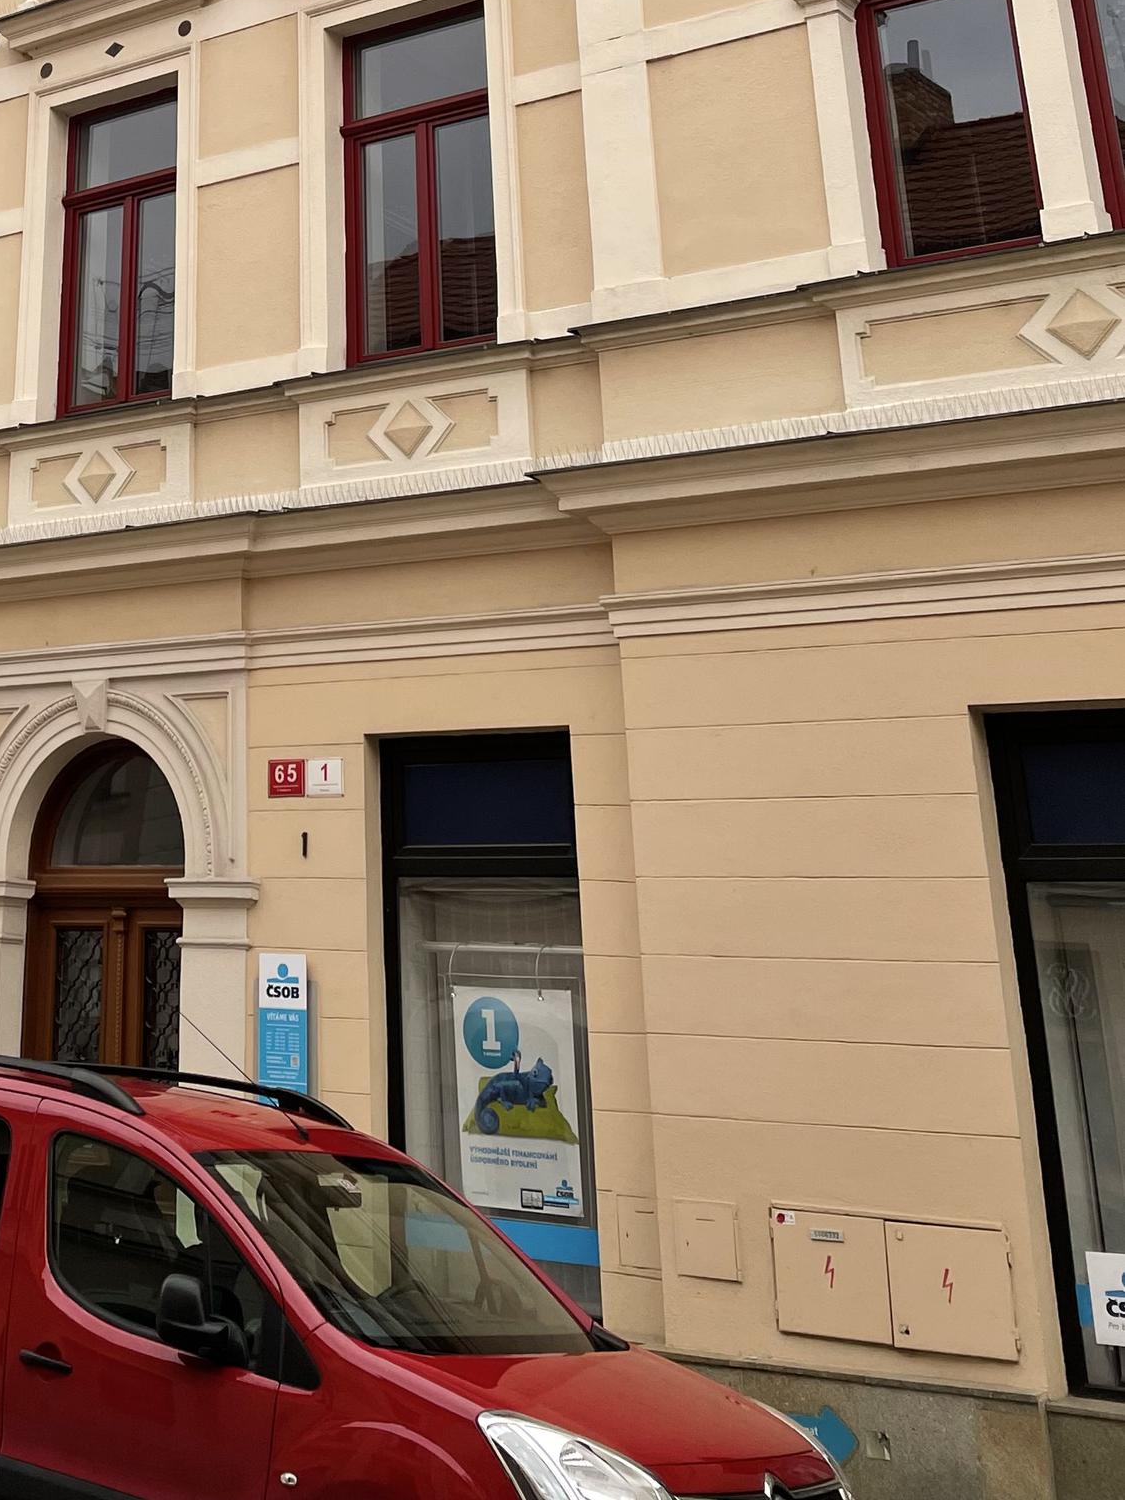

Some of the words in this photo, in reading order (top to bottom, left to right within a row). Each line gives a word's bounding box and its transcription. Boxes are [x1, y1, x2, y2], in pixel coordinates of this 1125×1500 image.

[274, 763, 297, 784] 65
[320, 763, 328, 782] 1
[266, 984, 300, 999] ČSOB
[481, 1008, 501, 1050] 1
